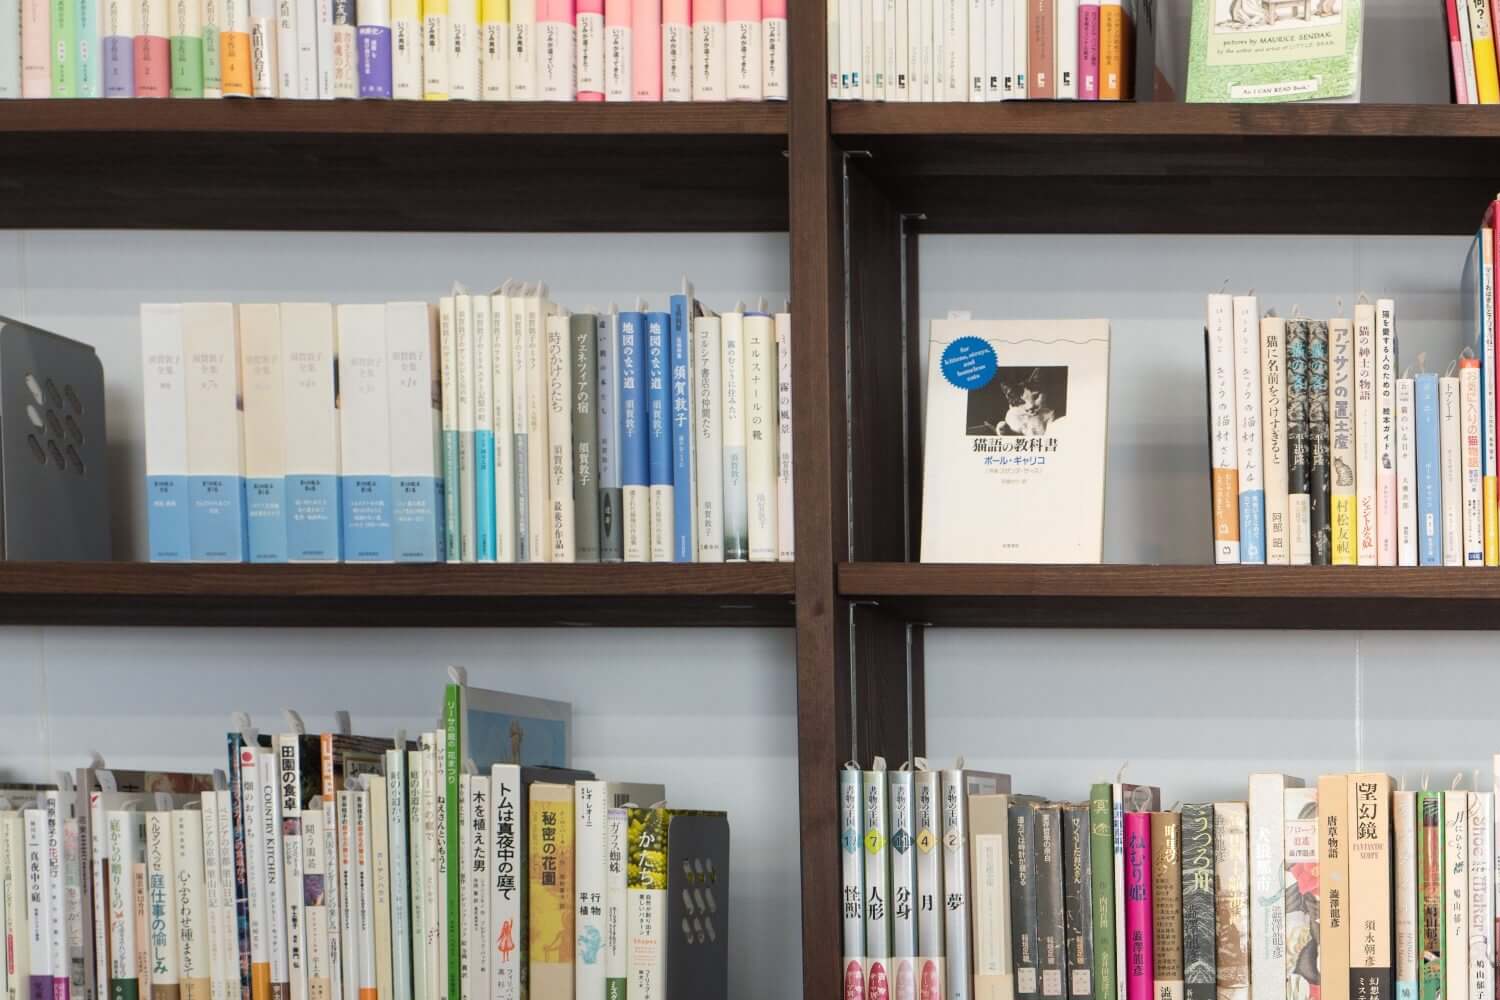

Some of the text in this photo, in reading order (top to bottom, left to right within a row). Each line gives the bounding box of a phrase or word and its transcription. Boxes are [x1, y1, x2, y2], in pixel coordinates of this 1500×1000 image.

[1260, 35, 1294, 44] MAURICE
[622, 321, 635, 389] 地図のない道
[649, 322, 662, 389] 地図のない道
[750, 337, 762, 441] ユルスナールの靴
[973, 438, 1058, 454] 猫語の教科書
[263, 784, 275, 836] COUNTRY
[282, 744, 297, 813] 田園の食卓
[472, 790, 486, 874] 木を植えた男
[496, 782, 515, 901] トムは真夜中の庭で
[541, 810, 556, 887] 秘密の花園
[868, 885, 884, 921] 人形
[895, 885, 912, 921] 分身
[946, 892, 965, 912] 夢
